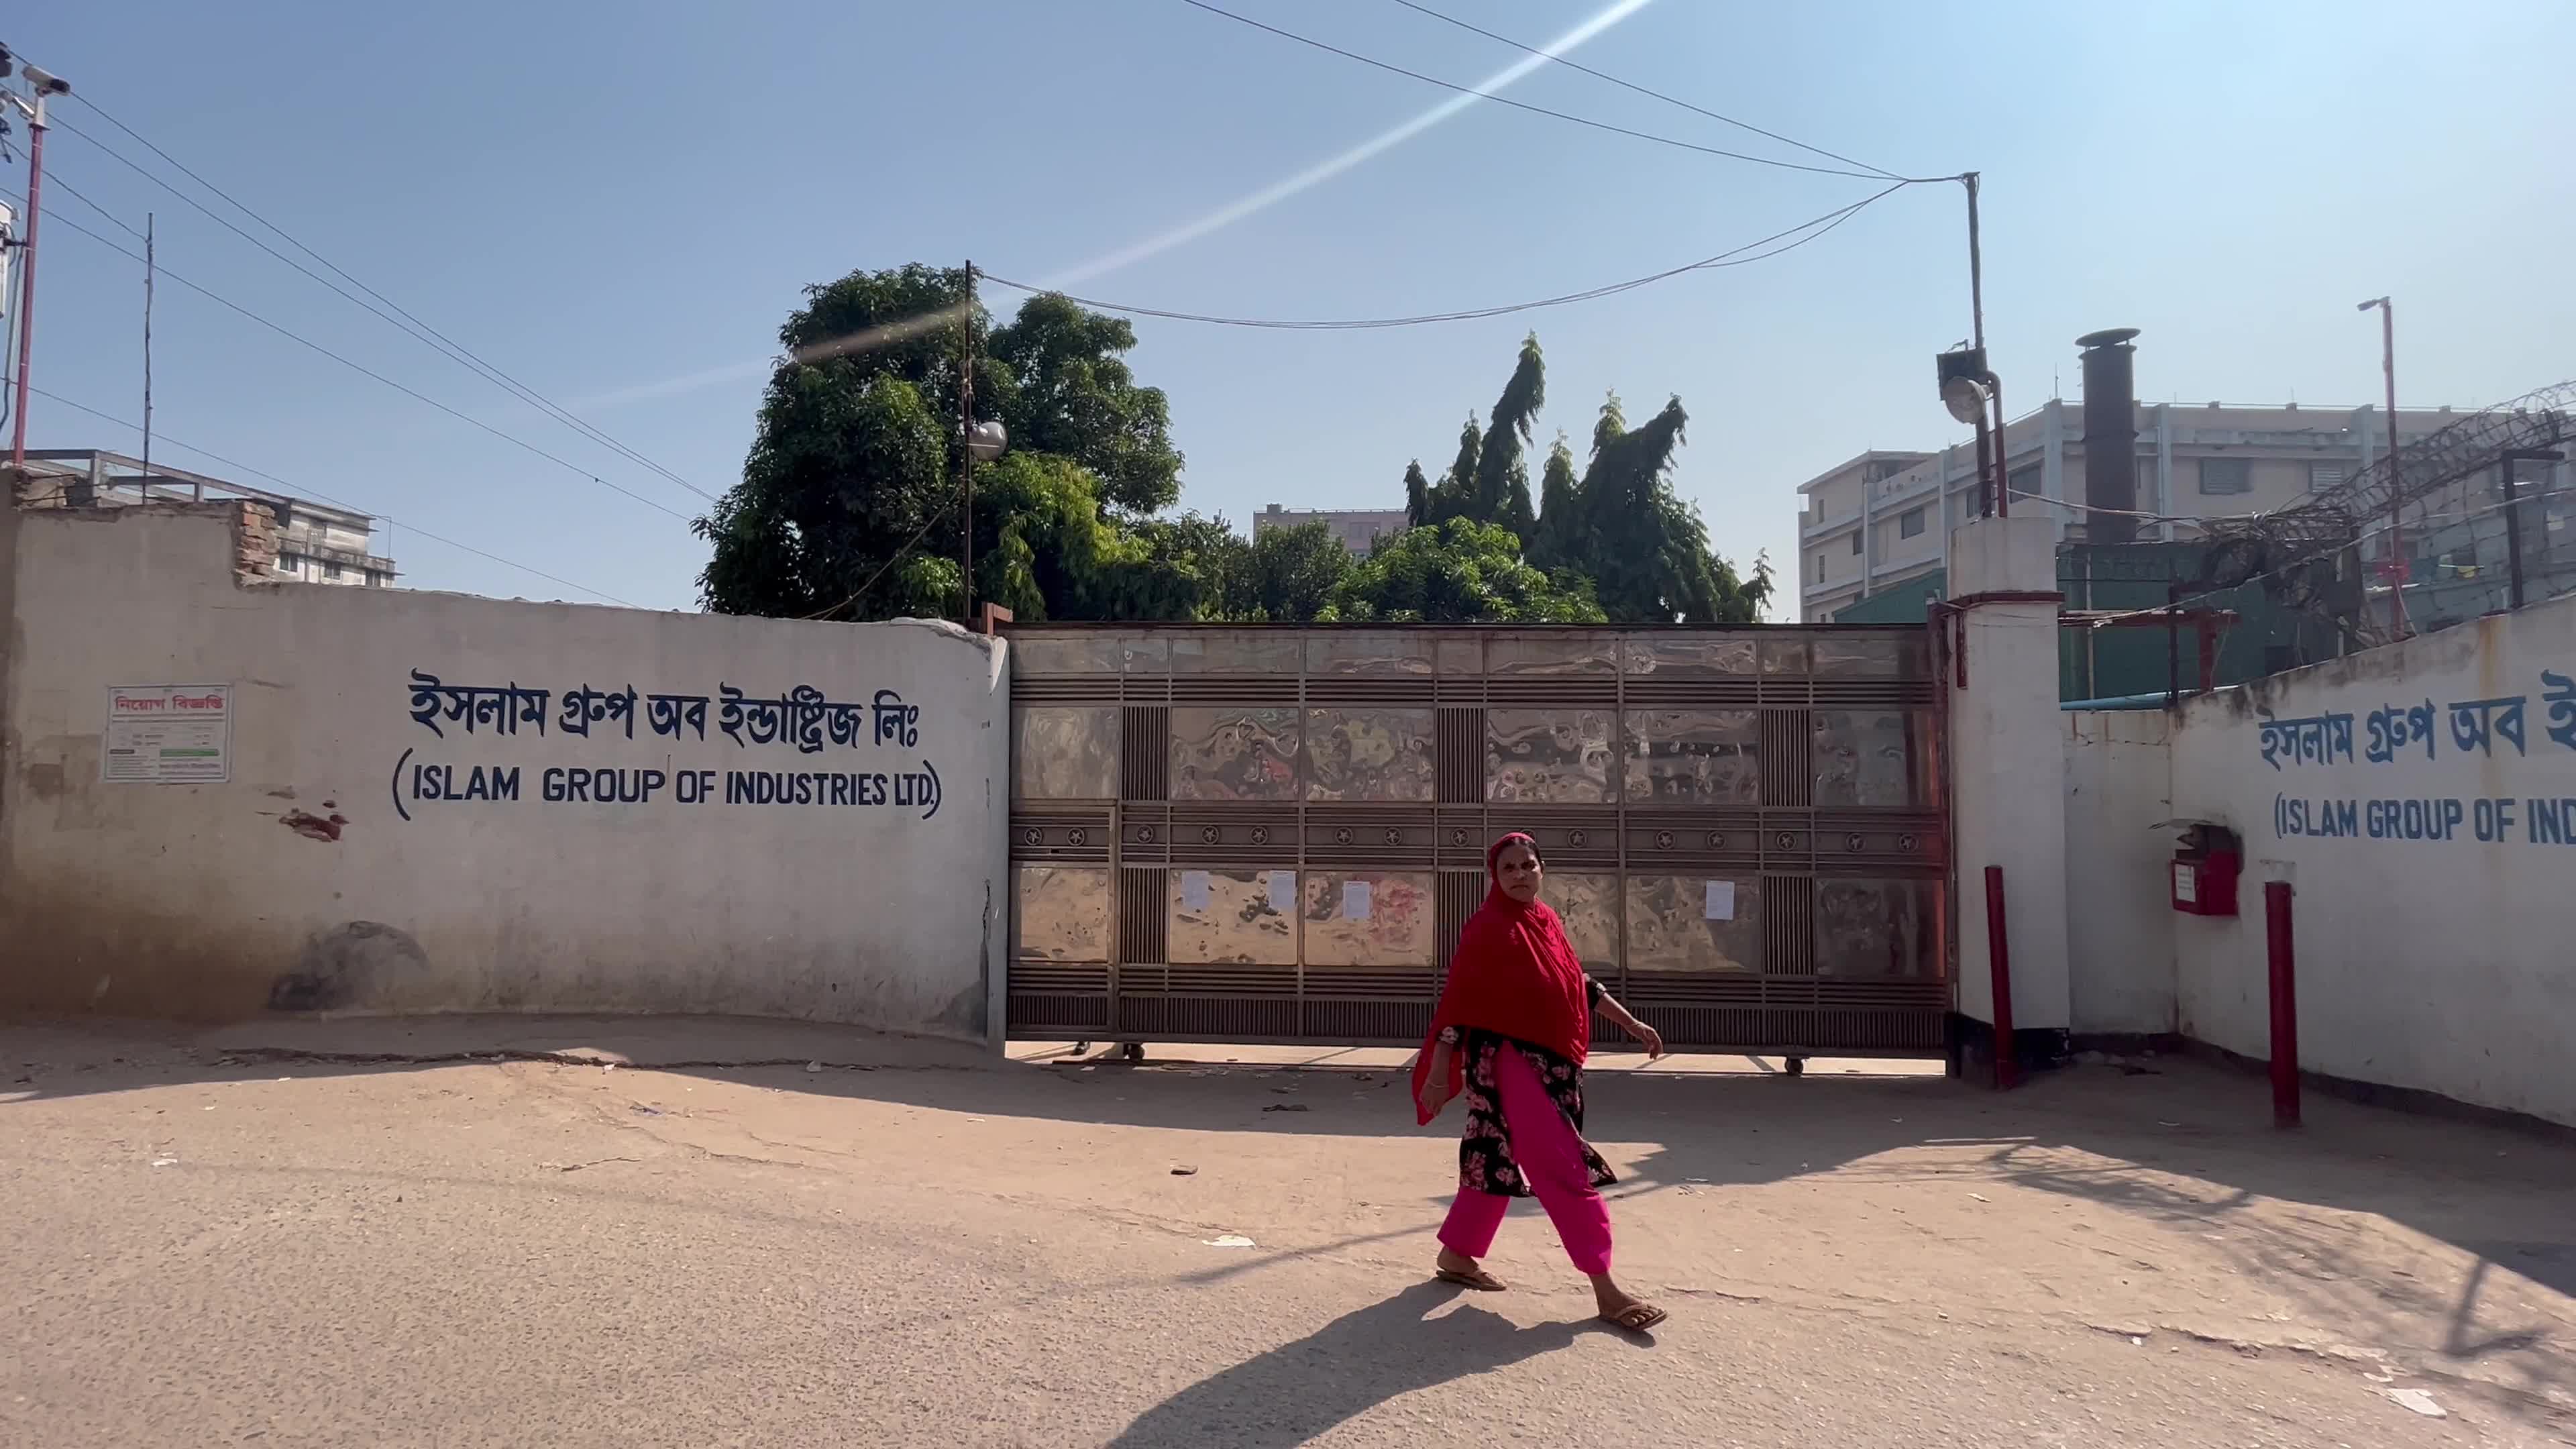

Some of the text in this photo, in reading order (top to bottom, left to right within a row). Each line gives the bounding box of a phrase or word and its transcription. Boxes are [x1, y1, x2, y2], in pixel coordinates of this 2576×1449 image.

[408, 667, 551, 739] ইসলাম
[558, 683, 638, 739] গ্রুপ
[647, 694, 710, 741] অব
[2257, 705, 2354, 771] ইসলাম
[2365, 697, 2436, 763] গ্রুপ
[2448, 695, 2526, 758] অব
[392, 747, 521, 821] (ISLAM
[542, 768, 665, 803] GROUP
[676, 770, 716, 804] OF
[726, 771, 888, 806] INDUSTRIES
[2275, 792, 2359, 839] (ISLAM
[2366, 798, 2463, 841] GROUP
[2473, 798, 2516, 843] OF
